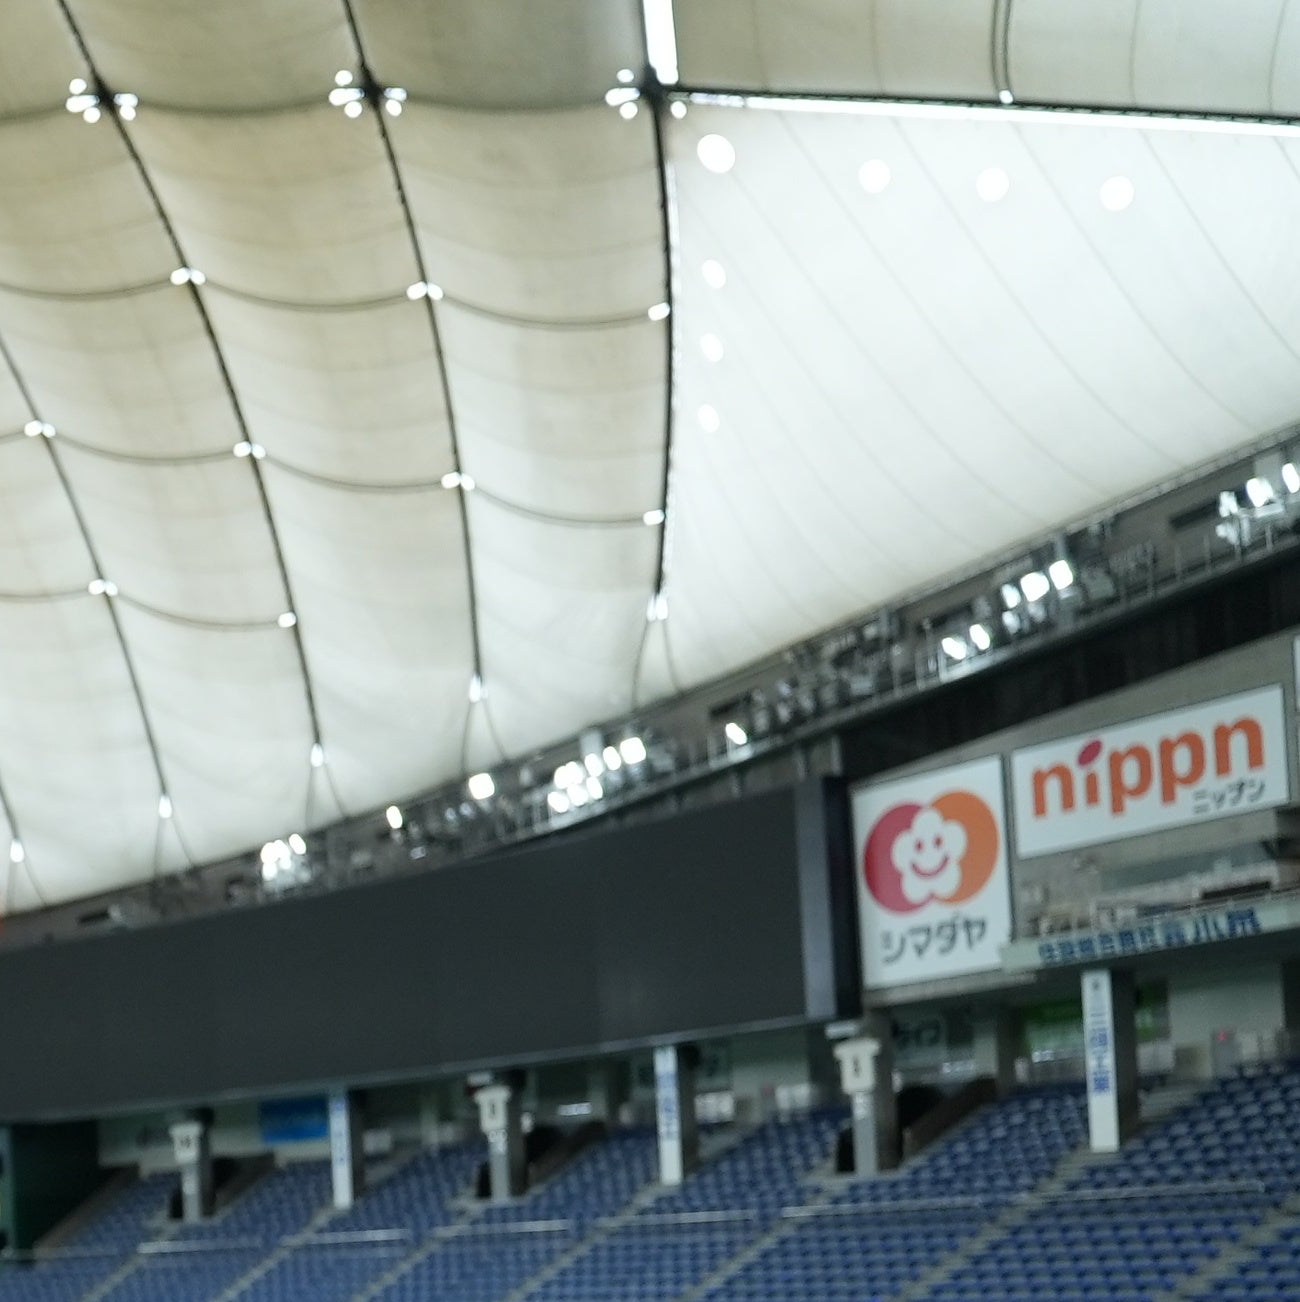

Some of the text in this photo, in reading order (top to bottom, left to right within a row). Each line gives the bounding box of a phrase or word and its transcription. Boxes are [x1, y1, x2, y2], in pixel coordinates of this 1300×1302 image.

[1032, 717, 1264, 816] nippn
[1192, 778, 1265, 815] ニップン
[881, 911, 987, 964] シマダヤ
